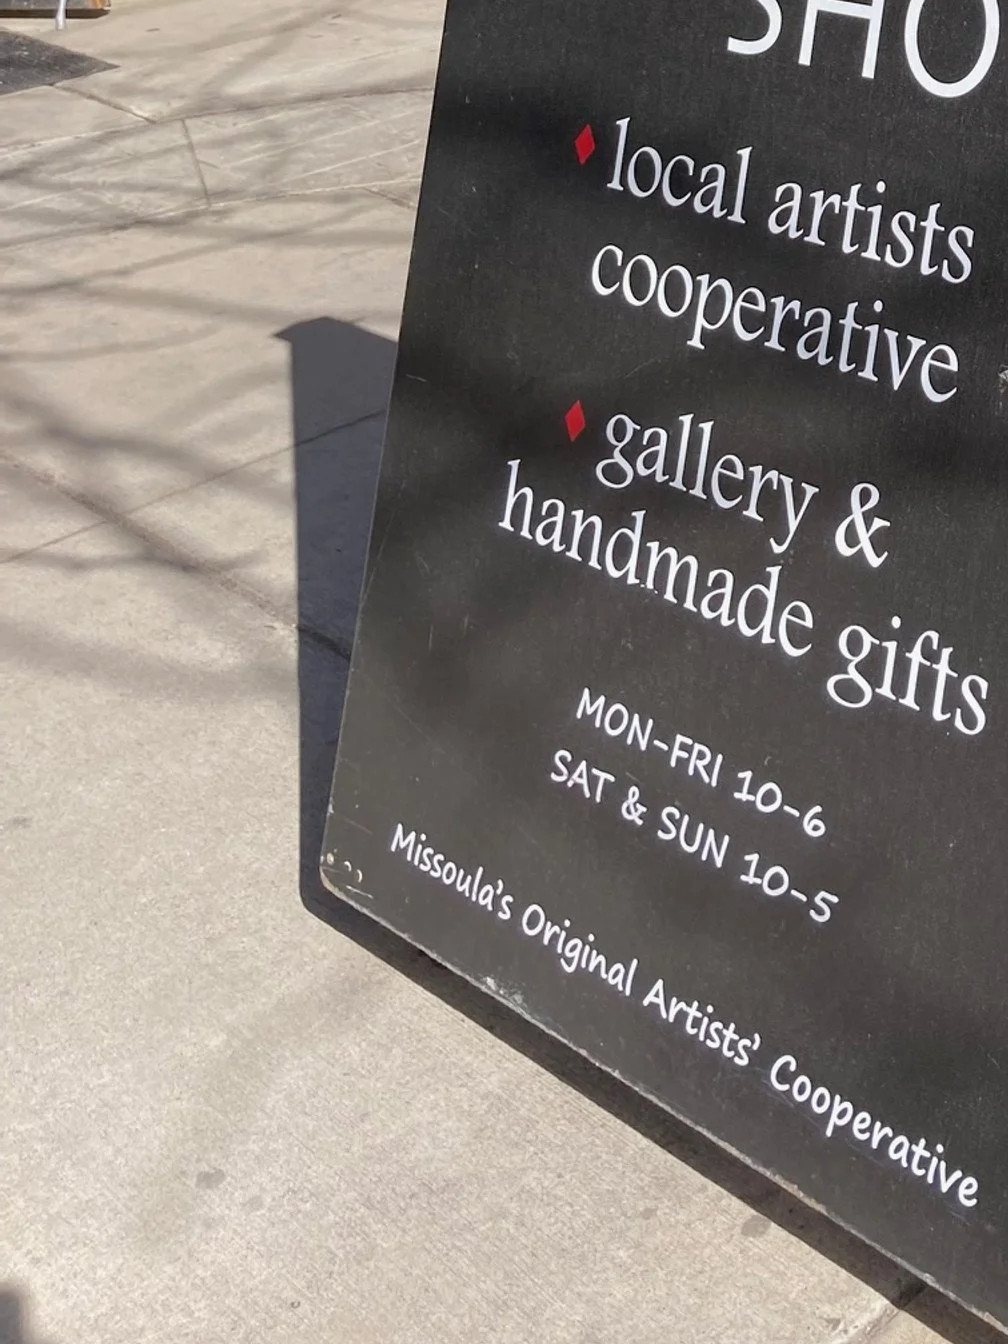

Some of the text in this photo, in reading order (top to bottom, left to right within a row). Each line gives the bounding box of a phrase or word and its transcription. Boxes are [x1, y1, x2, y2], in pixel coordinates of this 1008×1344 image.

[606, 117, 975, 284] local artists
[591, 244, 959, 403] cooperative
[595, 413, 891, 569] gallery &
[498, 458, 989, 736] handmade gifts
[550, 749, 840, 923] SAT & SUN 10-5
[575, 687, 827, 838] MON-FRI 10-6
[390, 822, 979, 1208] Missoula's Original Artists' Cooperative
